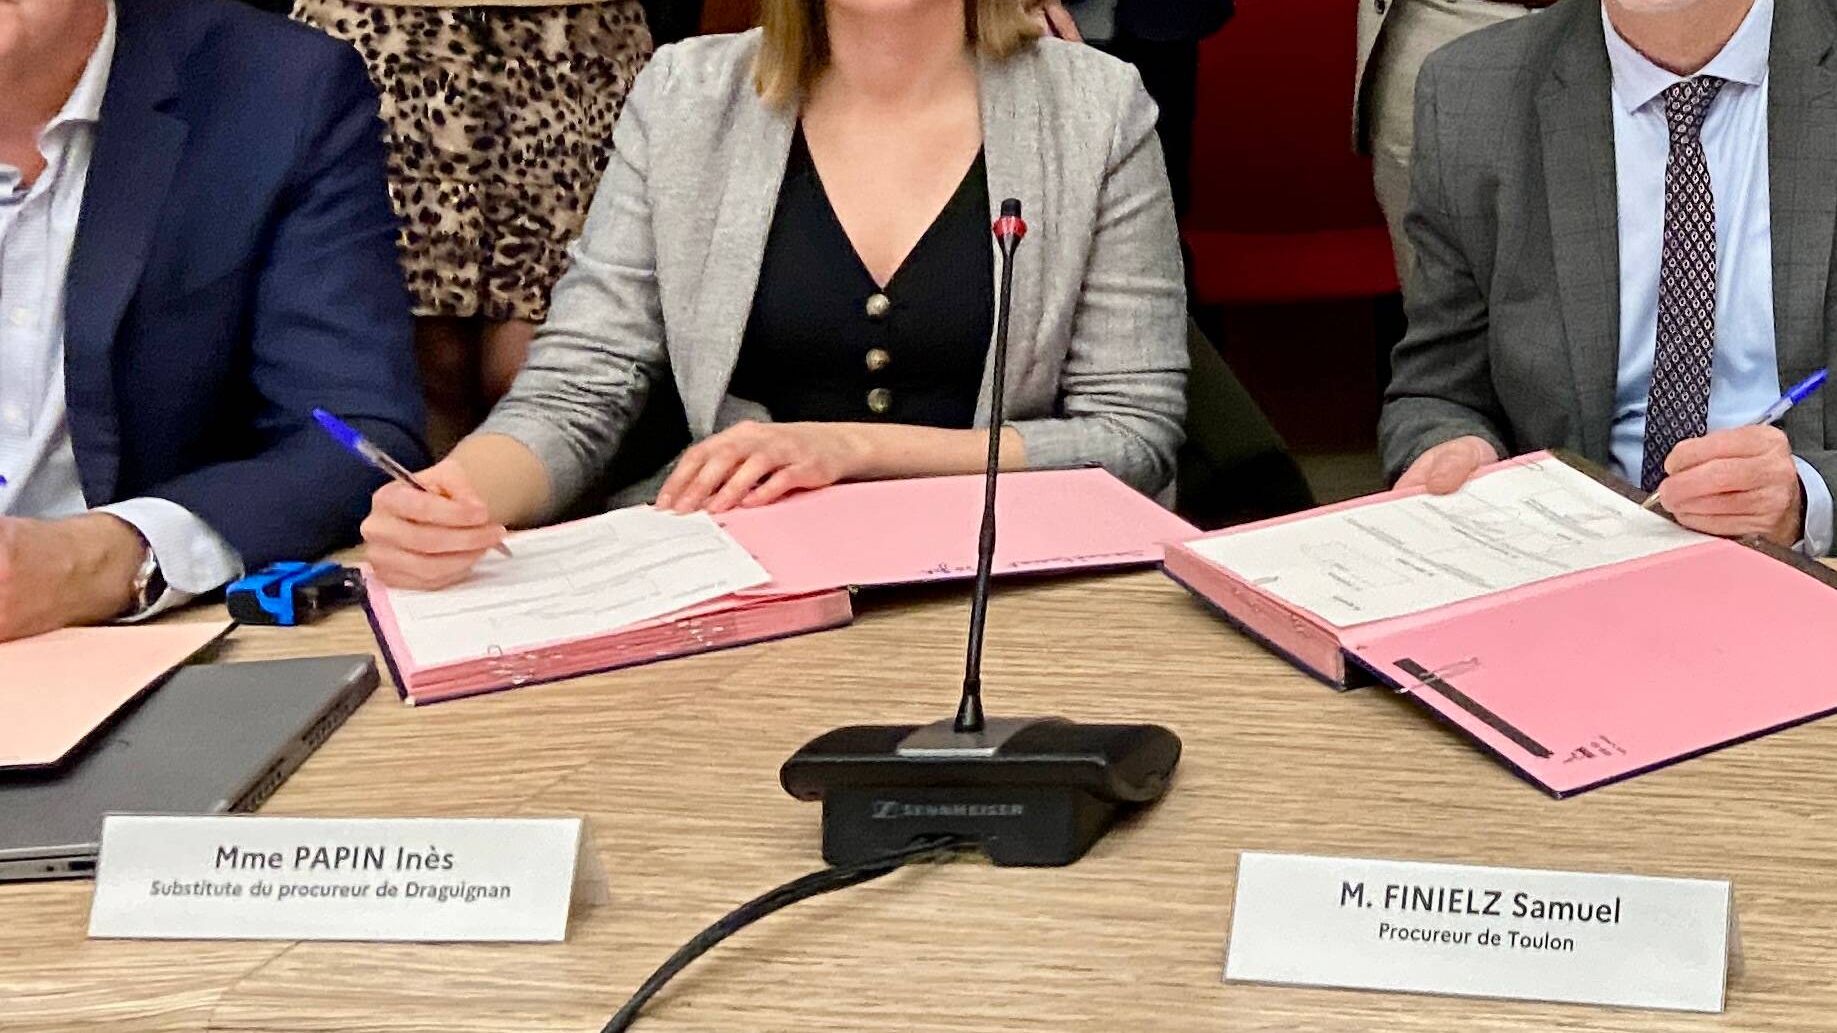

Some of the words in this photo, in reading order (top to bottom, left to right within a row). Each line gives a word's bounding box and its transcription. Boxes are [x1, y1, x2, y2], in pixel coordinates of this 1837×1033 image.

[215, 845, 283, 870] Mme
[294, 845, 386, 870] PAPIN
[396, 844, 455, 871] Inès
[150, 880, 243, 897] Substitute
[250, 880, 273, 897] du
[277, 883, 371, 901] procureur
[375, 880, 398, 898] de
[405, 881, 511, 903] Draguignan
[1340, 880, 1373, 909] M.
[1384, 883, 1502, 916] FINIELZ
[1511, 892, 1621, 924] Samuel
[1378, 922, 1473, 945] Procureur
[1477, 927, 1501, 947] de
[1508, 930, 1575, 952] Toulon
